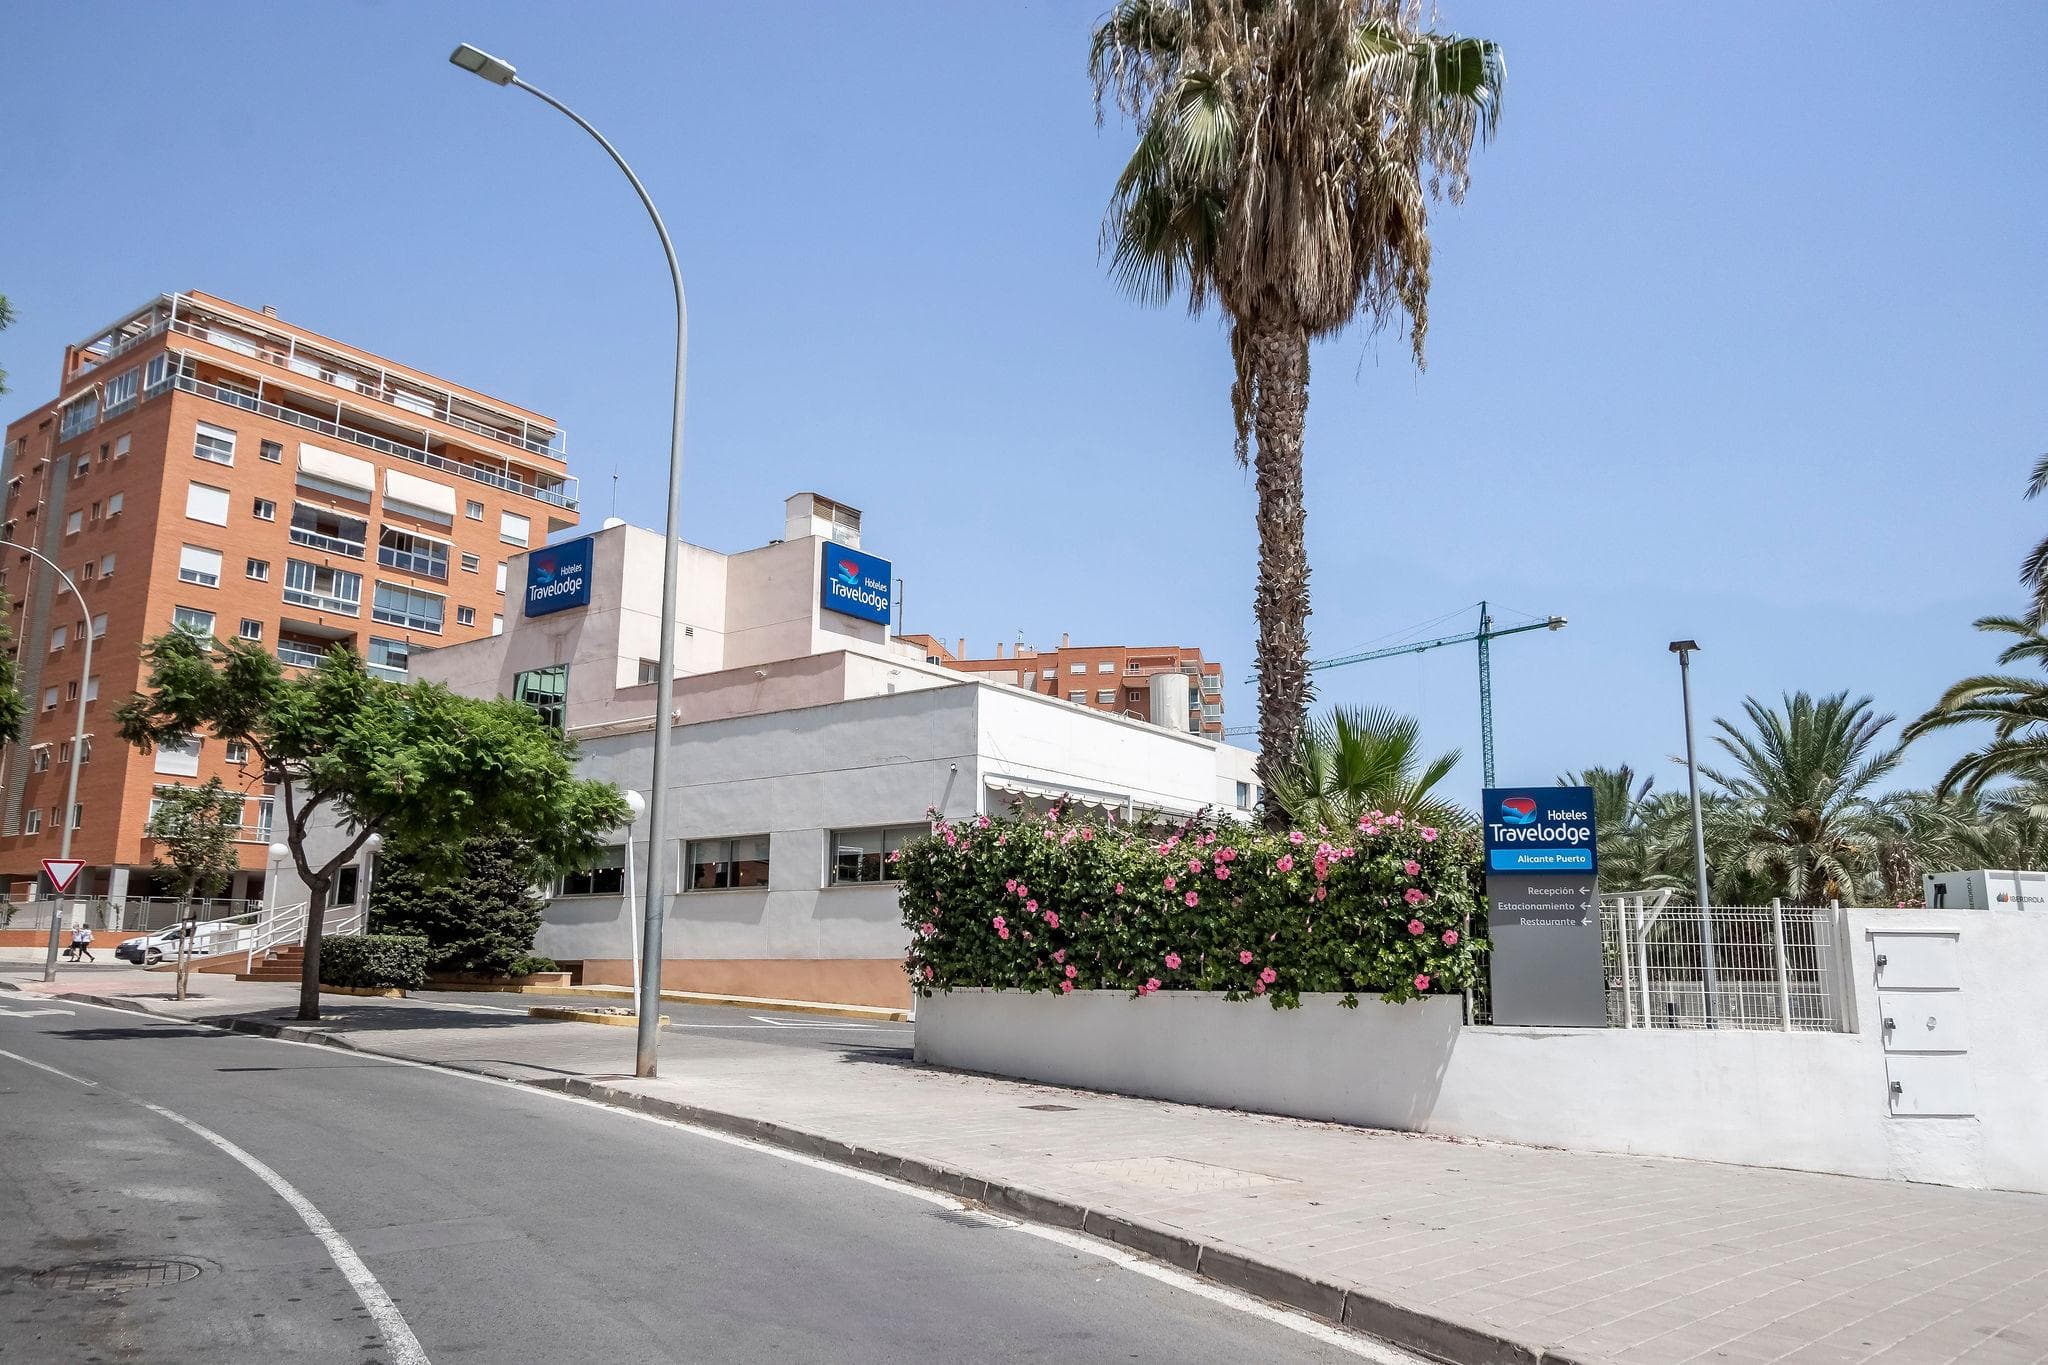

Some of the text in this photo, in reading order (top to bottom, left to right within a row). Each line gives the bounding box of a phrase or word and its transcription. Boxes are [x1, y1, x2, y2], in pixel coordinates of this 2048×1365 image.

[561, 563, 582, 576] Hoteles
[529, 576, 583, 601] Travelodge
[864, 577, 888, 592] Hoteles
[830, 577, 888, 611] Travelodge
[1547, 810, 1588, 821] Hoteles
[1489, 823, 1591, 845] Travelodge
[1517, 855, 1586, 863] Alicante Puerto
[1528, 886, 1575, 897] Recepción
[1965, 877, 1976, 909] BERDROLA
[2009, 895, 2046, 904] IBERDROLA
[1498, 903, 1575, 911] Estacionamiento
[1520, 918, 1576, 926] Restaurante
